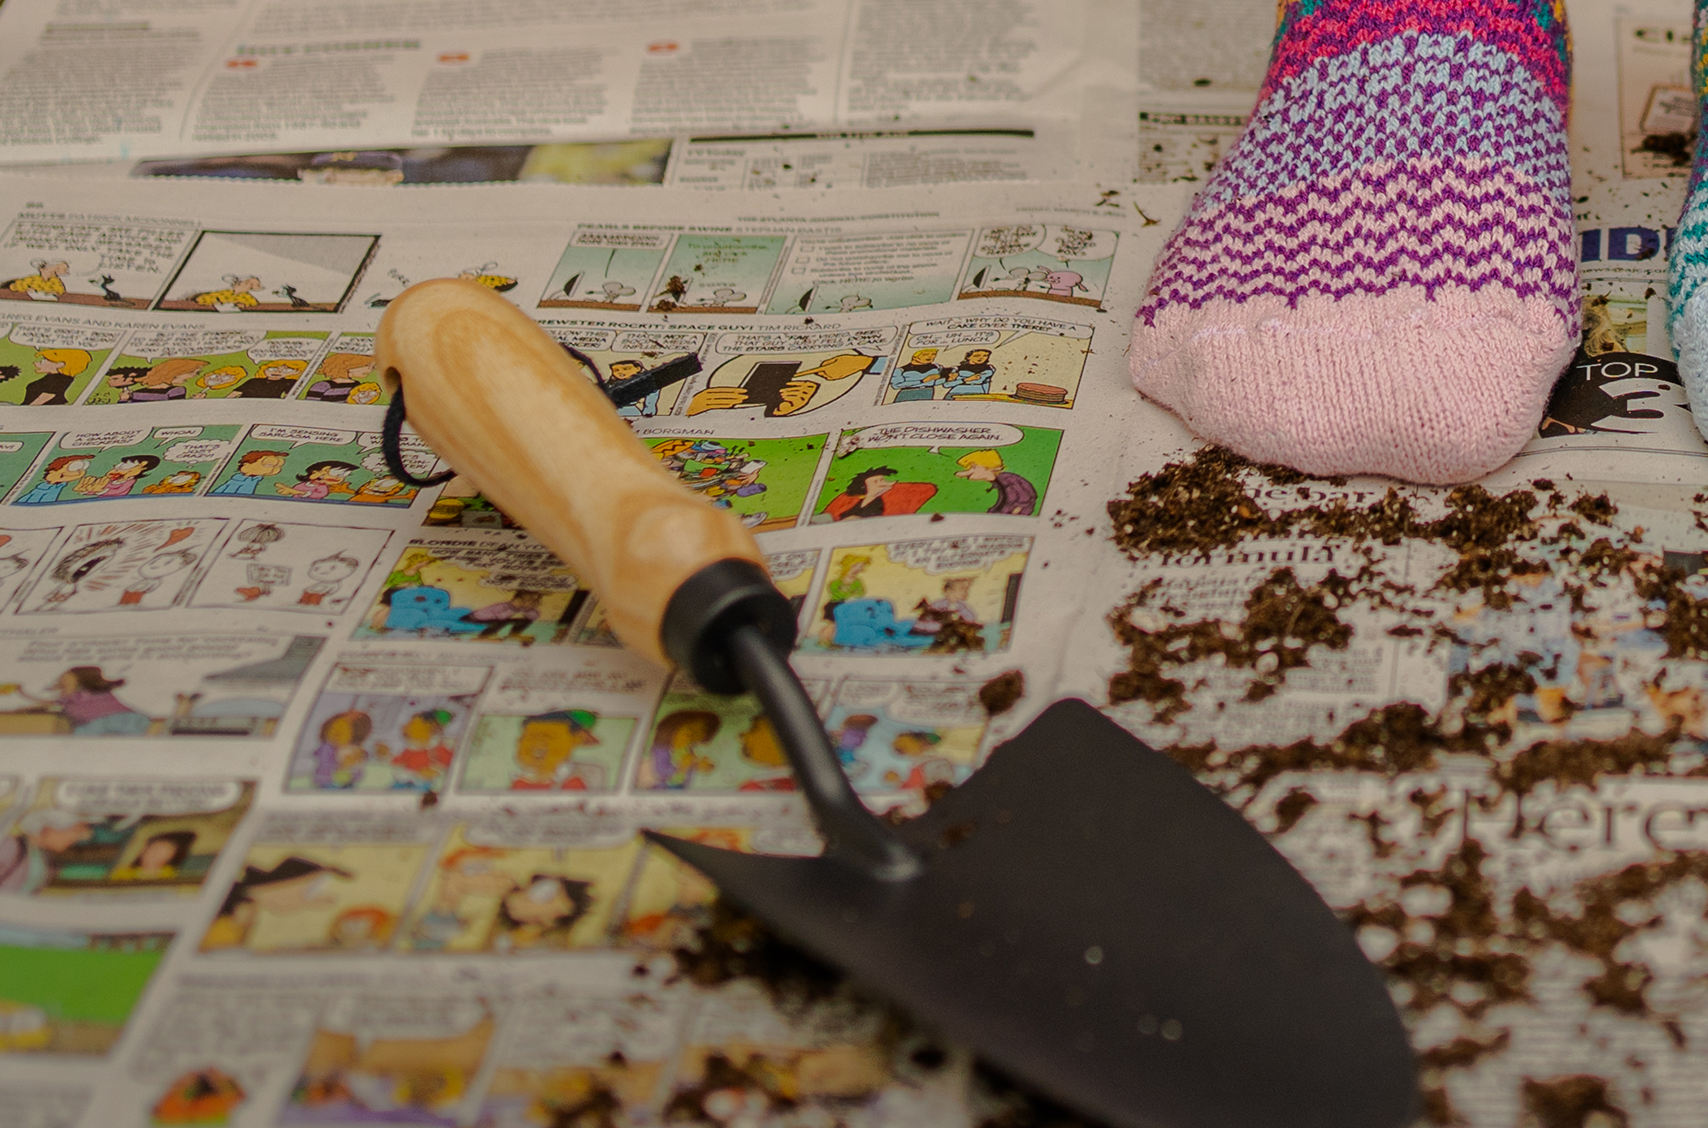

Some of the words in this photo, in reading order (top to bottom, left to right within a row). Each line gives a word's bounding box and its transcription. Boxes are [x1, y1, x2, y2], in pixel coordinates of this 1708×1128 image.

[1038, 320, 1067, 329] HAVE
[787, 343, 843, 351] CARRYING
[1576, 361, 1659, 381] TOP
[1590, 377, 1690, 434] 3
[103, 429, 143, 437] ABOUT
[290, 428, 339, 438] SENSING
[904, 426, 992, 434] DISHWASHER
[258, 432, 312, 440] SARCASM
[868, 433, 907, 442] WON'T
[958, 433, 1004, 441] AGAIN.
[408, 538, 477, 547] BLONDIE
